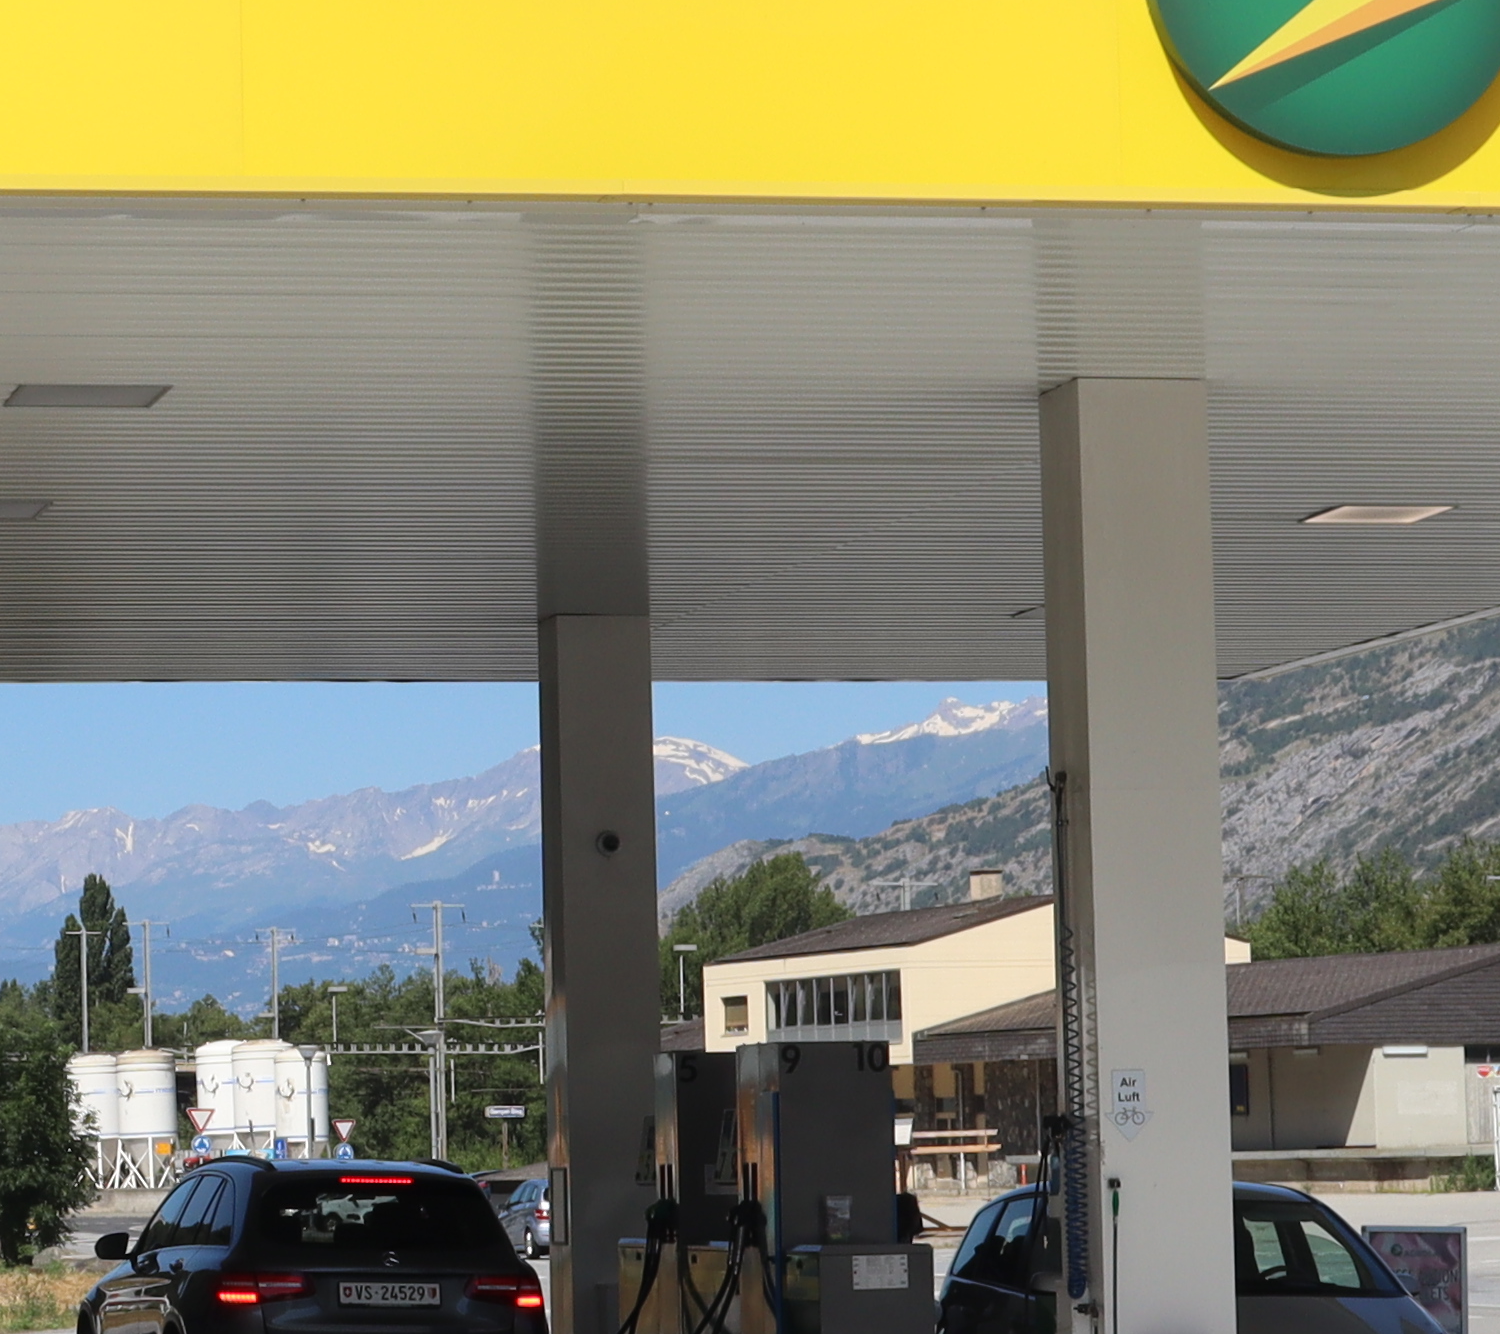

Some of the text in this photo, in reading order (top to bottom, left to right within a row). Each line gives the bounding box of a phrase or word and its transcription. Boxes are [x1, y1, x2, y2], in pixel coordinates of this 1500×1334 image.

[680, 1053, 698, 1083] 5
[781, 1044, 801, 1074] 9
[854, 1042, 890, 1073] 10
[1120, 1077, 1137, 1088] Air
[1117, 1091, 1141, 1102] Luft
[381, 1285, 425, 1301] 24529
